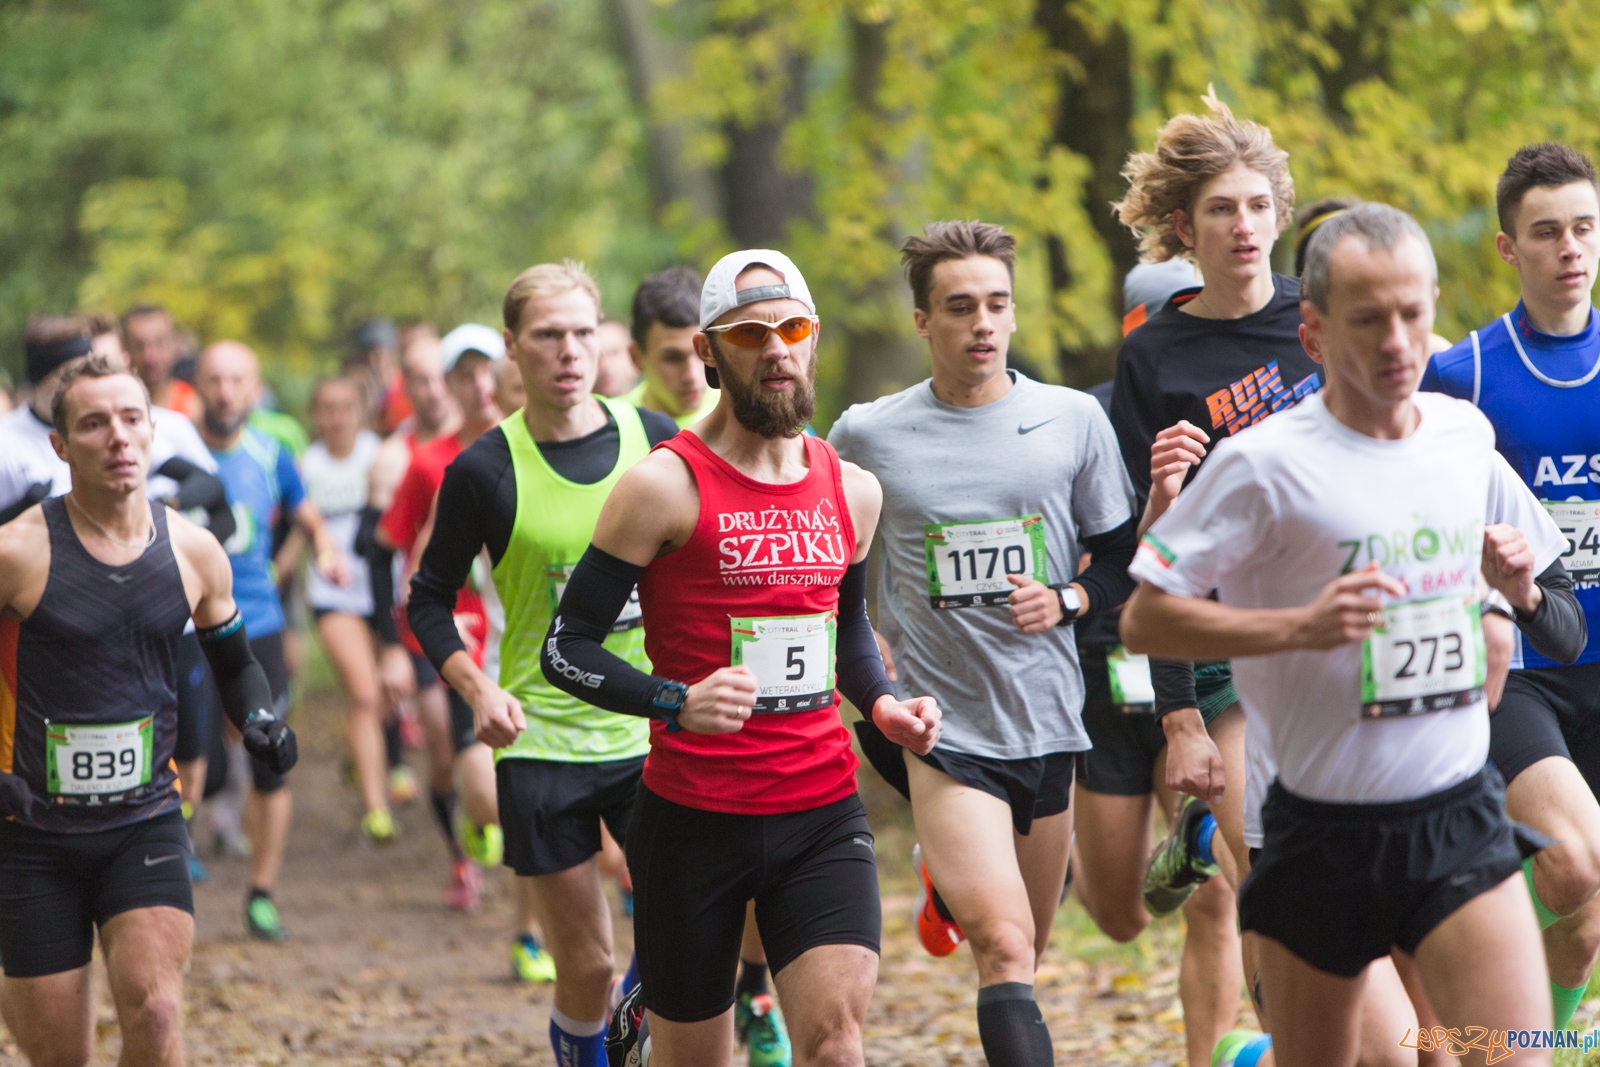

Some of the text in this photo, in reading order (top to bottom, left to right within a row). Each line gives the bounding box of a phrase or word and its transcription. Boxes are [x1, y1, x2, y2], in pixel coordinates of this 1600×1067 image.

[1205, 359, 1285, 430] RUN
[718, 504, 825, 532] DRUŻYNA
[719, 531, 845, 569] SZPIKU
[948, 545, 1026, 581] 1170
[1570, 559, 1594, 569] ADAM
[976, 582, 1003, 591] CZYSZ
[547, 637, 605, 689] BROOKS
[786, 645, 805, 681] 5
[1394, 633, 1465, 678] 273
[760, 682, 822, 695] WETERAN CYKLU
[72, 748, 136, 780] 839
